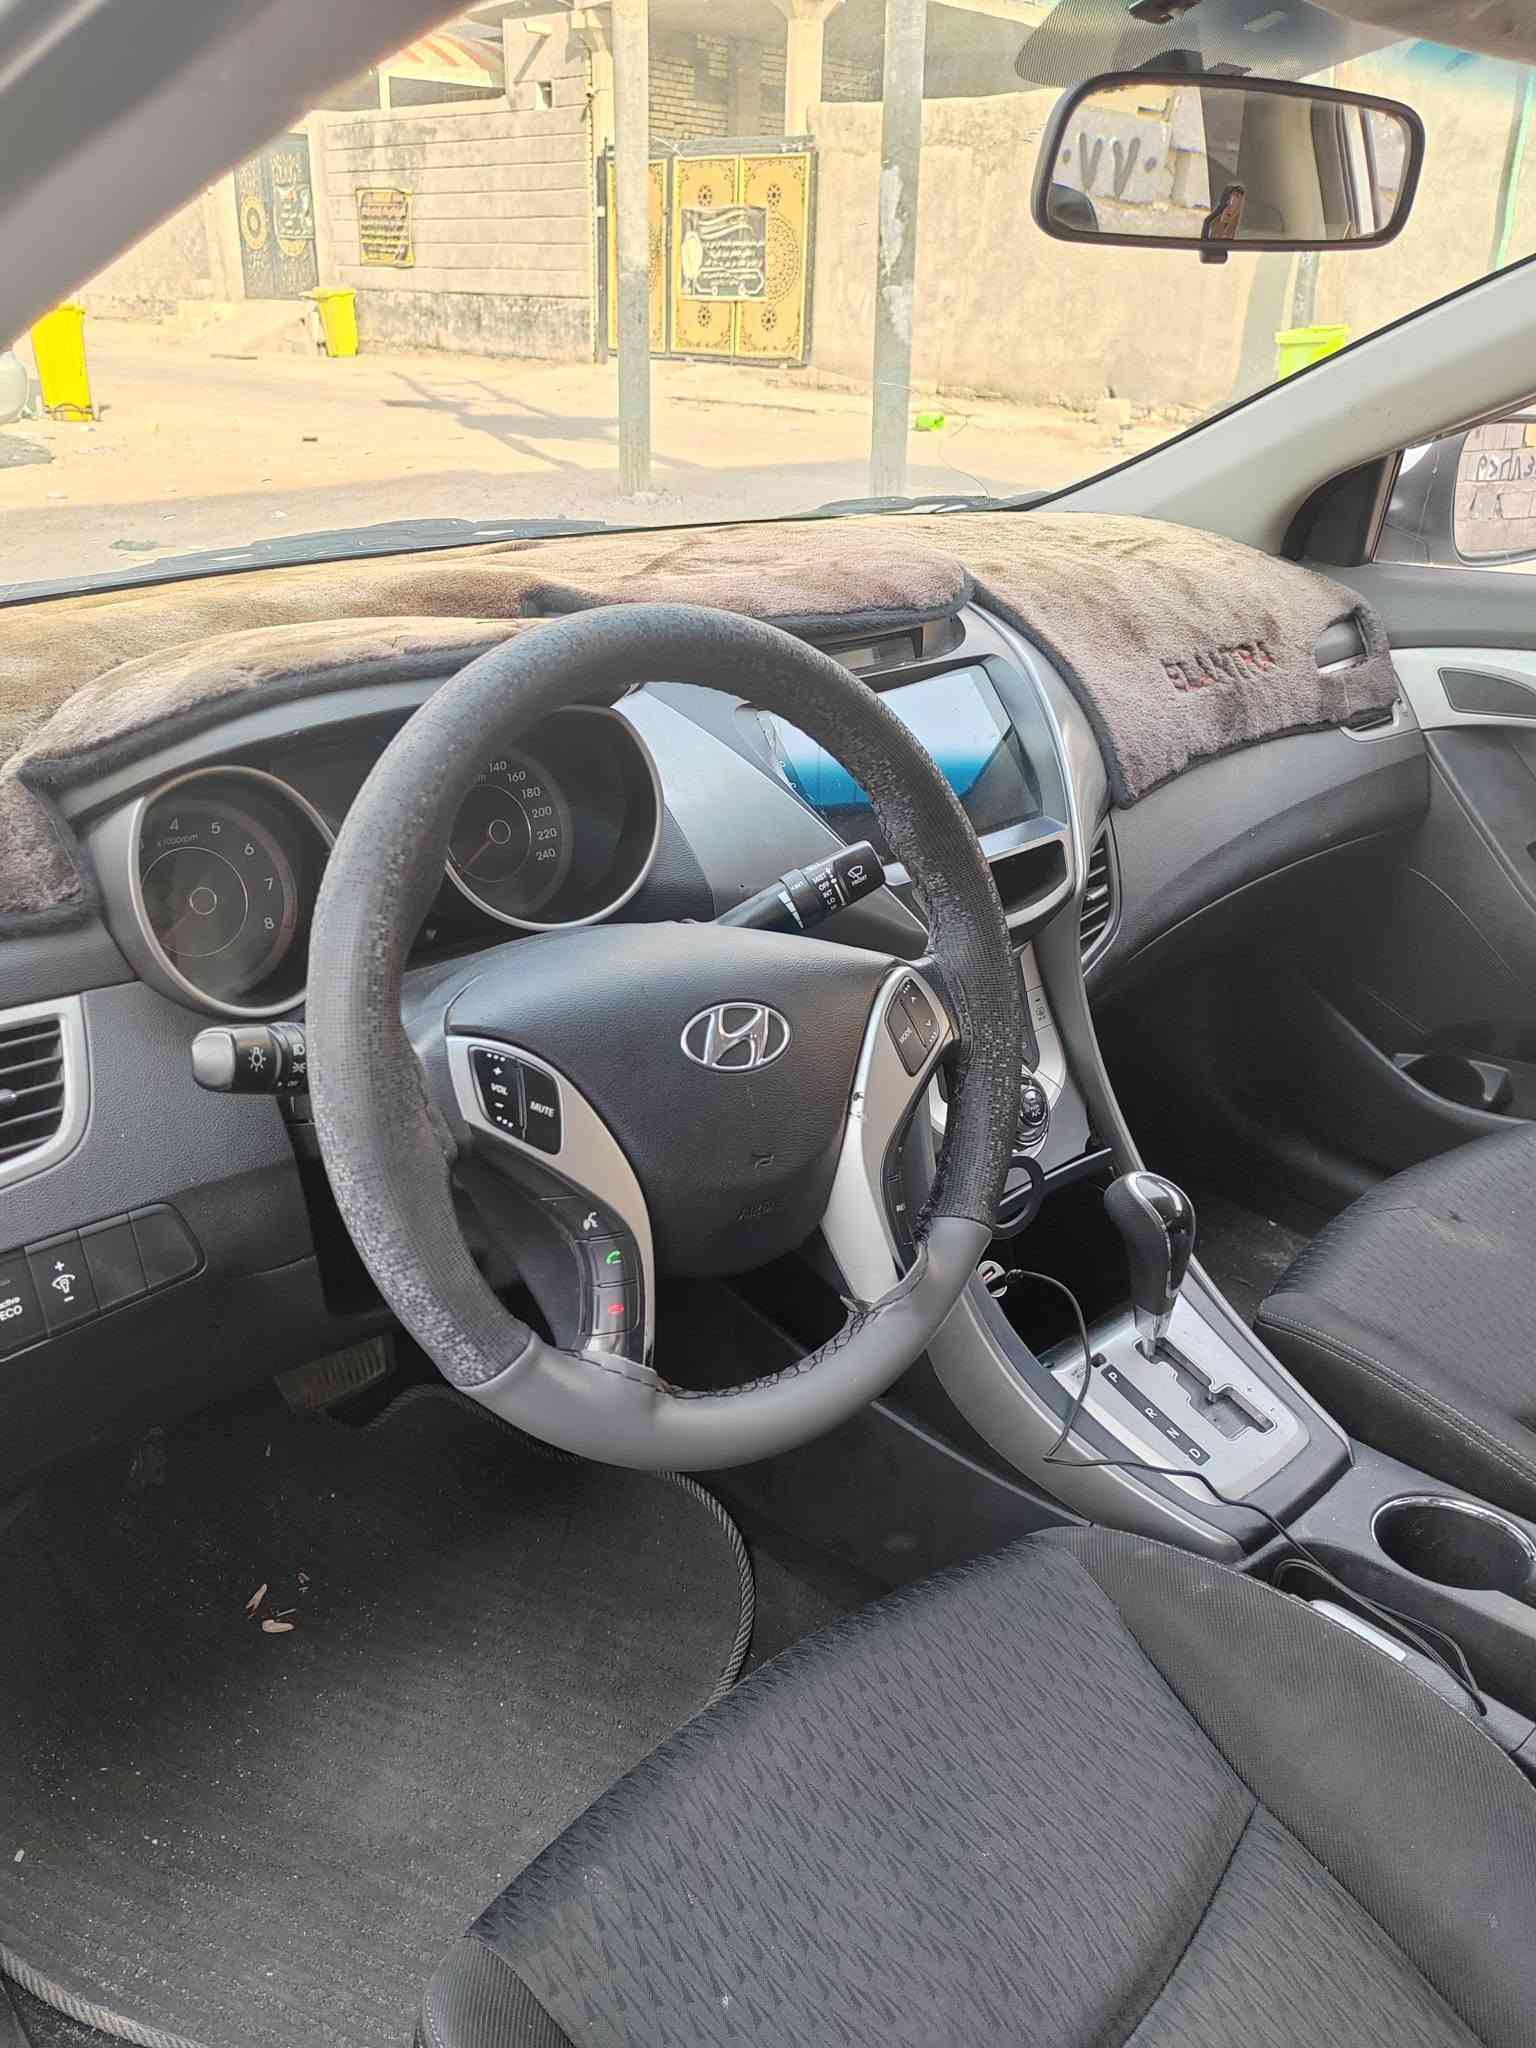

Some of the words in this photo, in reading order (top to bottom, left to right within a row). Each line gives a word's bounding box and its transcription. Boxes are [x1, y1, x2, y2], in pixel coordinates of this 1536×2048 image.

[489, 760, 507, 773] 140
[507, 770, 526, 783] 160
[521, 786, 541, 800] 180
[532, 806, 552, 818] 200
[169, 817, 179, 831] 4
[211, 822, 221, 834] 5
[536, 827, 557, 840] 220
[244, 843, 255, 856] 6
[536, 848, 556, 861] 240
[264, 877, 273, 891] 7
[264, 917, 274, 929] 8
[490, 1082, 509, 1097] VOL
[529, 1100, 555, 1118] MUTE
[1108, 1371, 1118, 1383] P
[1144, 1407, 1158, 1419] R
[1166, 1427, 1180, 1439] N
[1188, 1448, 1201, 1459] D
